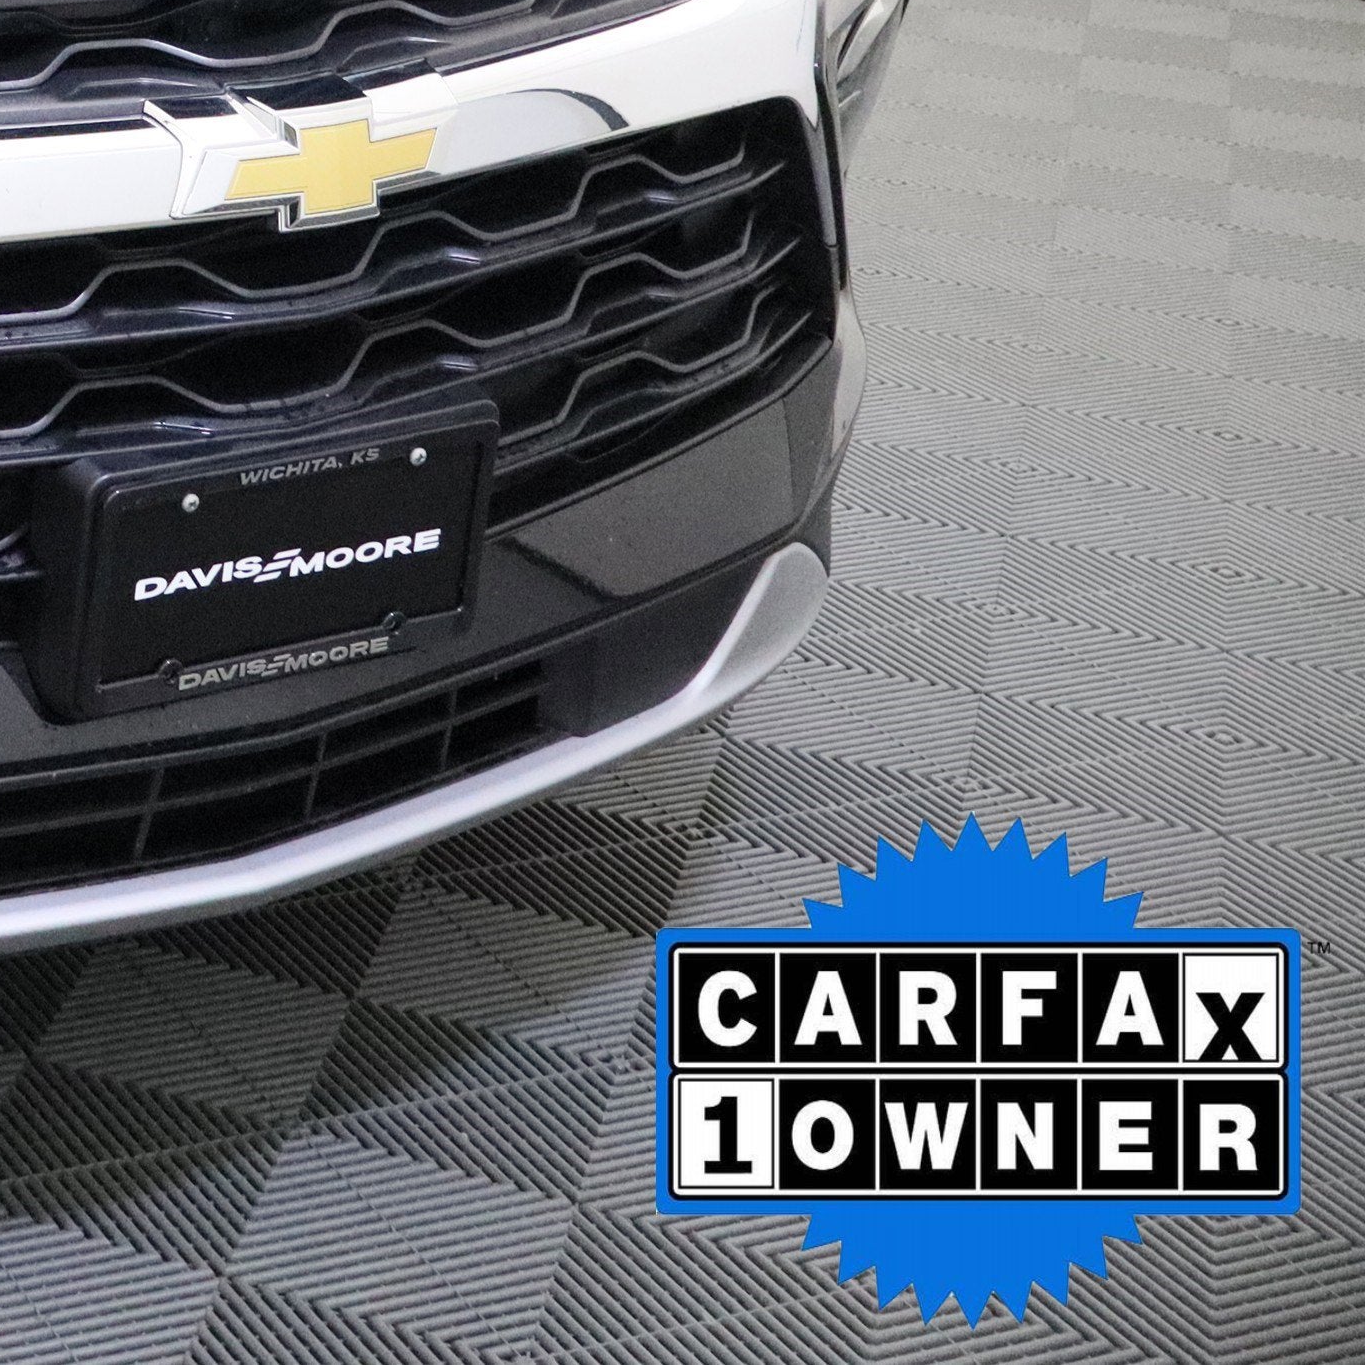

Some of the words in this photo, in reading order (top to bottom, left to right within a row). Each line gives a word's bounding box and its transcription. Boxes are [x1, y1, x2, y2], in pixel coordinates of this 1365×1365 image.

[240, 456, 343, 485] WICHITA,
[350, 447, 380, 465] KS
[134, 556, 263, 601] DAVIS
[289, 528, 441, 577] MOORE
[178, 658, 267, 691] DAVIS
[284, 636, 390, 673] MOORE
